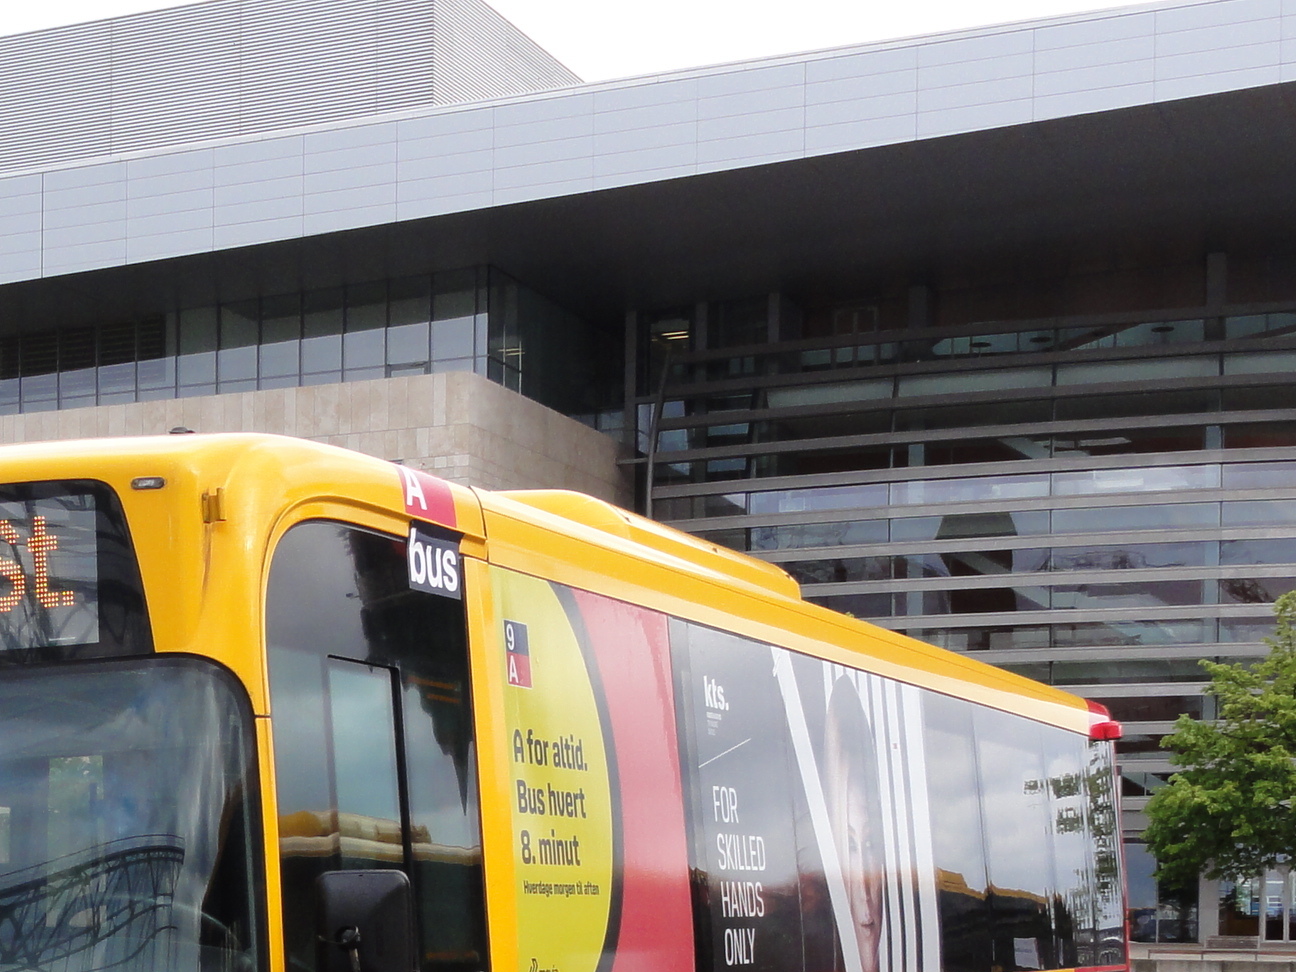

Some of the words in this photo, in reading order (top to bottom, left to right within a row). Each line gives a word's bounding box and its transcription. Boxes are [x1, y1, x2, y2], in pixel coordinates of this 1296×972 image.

[403, 466, 428, 510] A
[409, 527, 458, 592] bus
[506, 623, 515, 651] 9
[509, 655, 519, 683] A
[703, 675, 729, 711] kts.
[513, 729, 525, 763] A
[526, 729, 549, 766] for
[552, 734, 588, 771] altid.
[516, 779, 545, 815] Bus
[547, 782, 587, 819] hvert
[712, 785, 739, 823] FOR
[521, 830, 536, 865] 8.
[538, 829, 581, 866] minut
[717, 833, 766, 871] SKILLED
[523, 880, 553, 897] Hverdage
[553, 883, 576, 898] morgen
[720, 881, 764, 918] HANDS
[724, 928, 755, 966] ONLY
